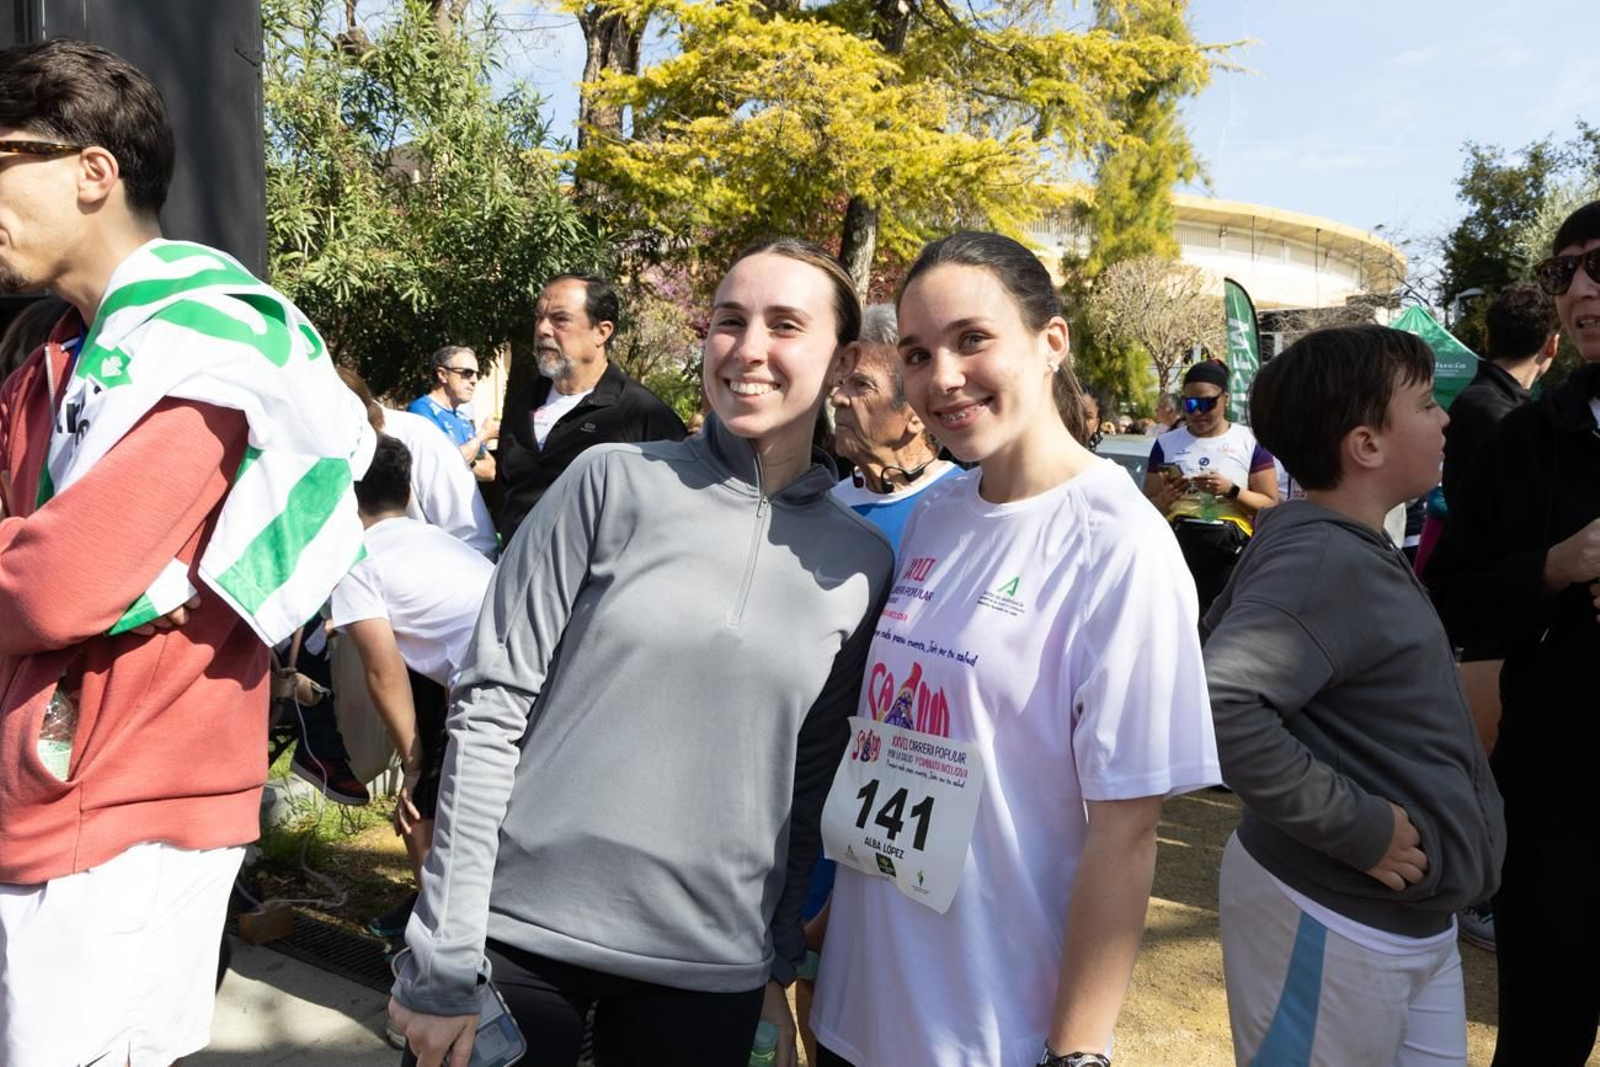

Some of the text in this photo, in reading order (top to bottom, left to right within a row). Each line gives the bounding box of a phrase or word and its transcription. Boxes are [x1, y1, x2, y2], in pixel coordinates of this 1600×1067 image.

[905, 588, 935, 601] POPULAR
[955, 649, 979, 667] salud
[908, 739, 935, 756] CARRERA
[934, 746, 968, 764] POPULAR
[856, 779, 935, 852] 141
[864, 836, 905, 860] ALBA LÓPEZ
